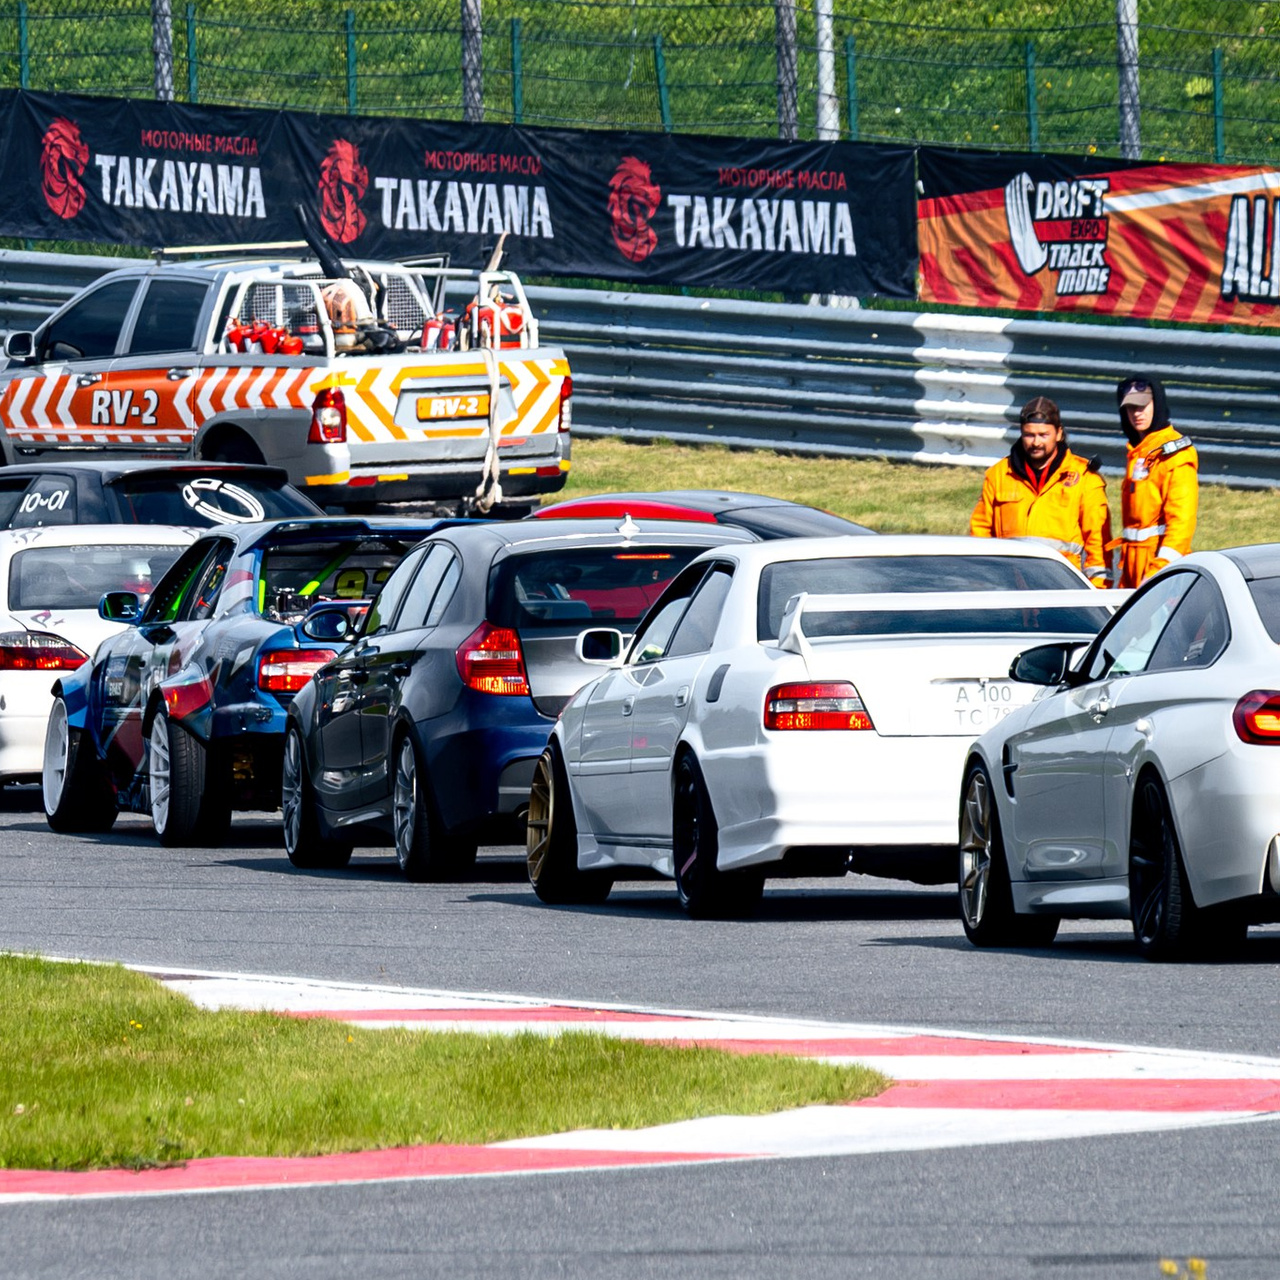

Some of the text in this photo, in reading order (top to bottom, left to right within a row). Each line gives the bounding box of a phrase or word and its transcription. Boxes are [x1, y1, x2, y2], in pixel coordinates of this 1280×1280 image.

[141, 129, 258, 157] МОТОРНЫЕ МАСЛА
[424, 150, 543, 176] МОТОРНЫЕ МАСЛА
[95, 153, 267, 218] TAKAYAMA
[718, 167, 847, 191] МОТОРНЫЕ МАСЛА
[374, 176, 554, 239] TAKAYAMA
[1035, 180, 1109, 220] DRIFT
[667, 193, 857, 257] TAKAYAMA
[1069, 220, 1100, 239] EXPO
[91, 388, 159, 426] RV-2
[430, 397, 479, 418] RV-2
[956, 685, 1011, 703] A 100
[954, 708, 984, 726] TC
